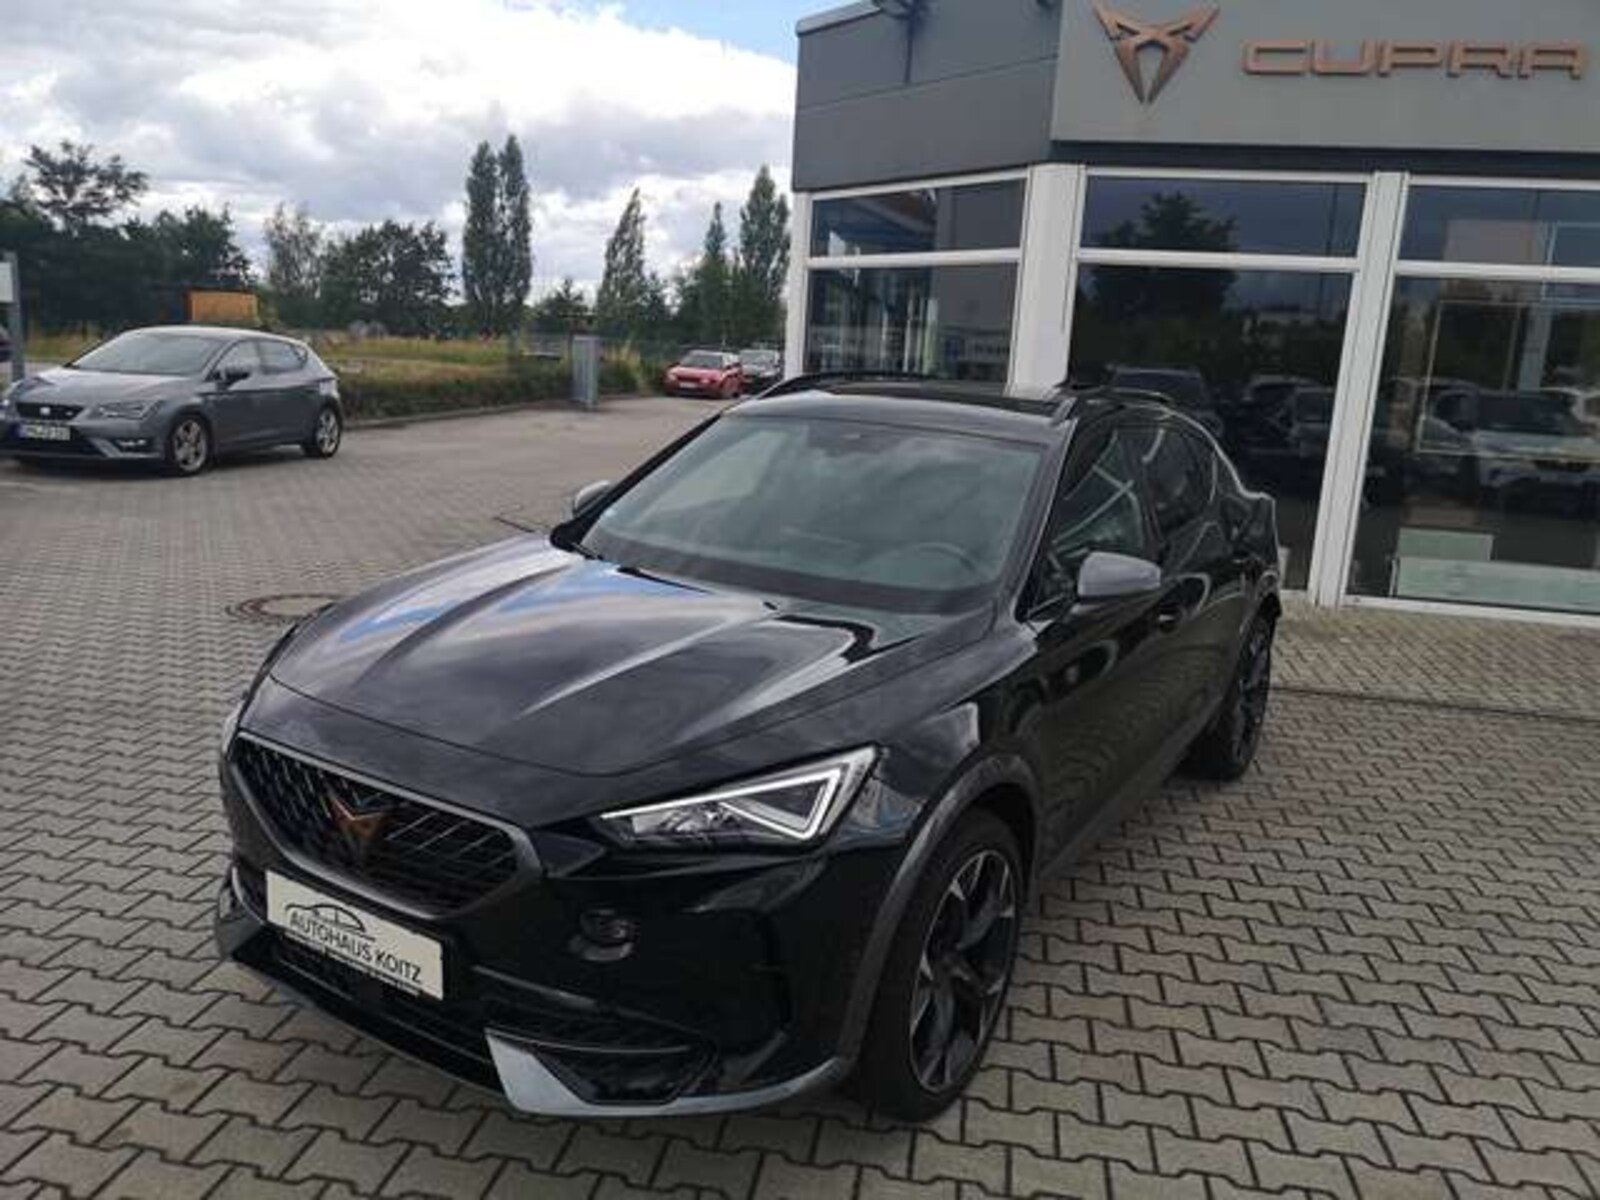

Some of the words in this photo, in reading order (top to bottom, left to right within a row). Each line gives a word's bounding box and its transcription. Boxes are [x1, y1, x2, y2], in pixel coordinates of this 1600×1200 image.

[1243, 40, 1586, 79] CUPRA
[290, 911, 372, 961] AUTOHAUS
[376, 950, 422, 983] KOITZ
